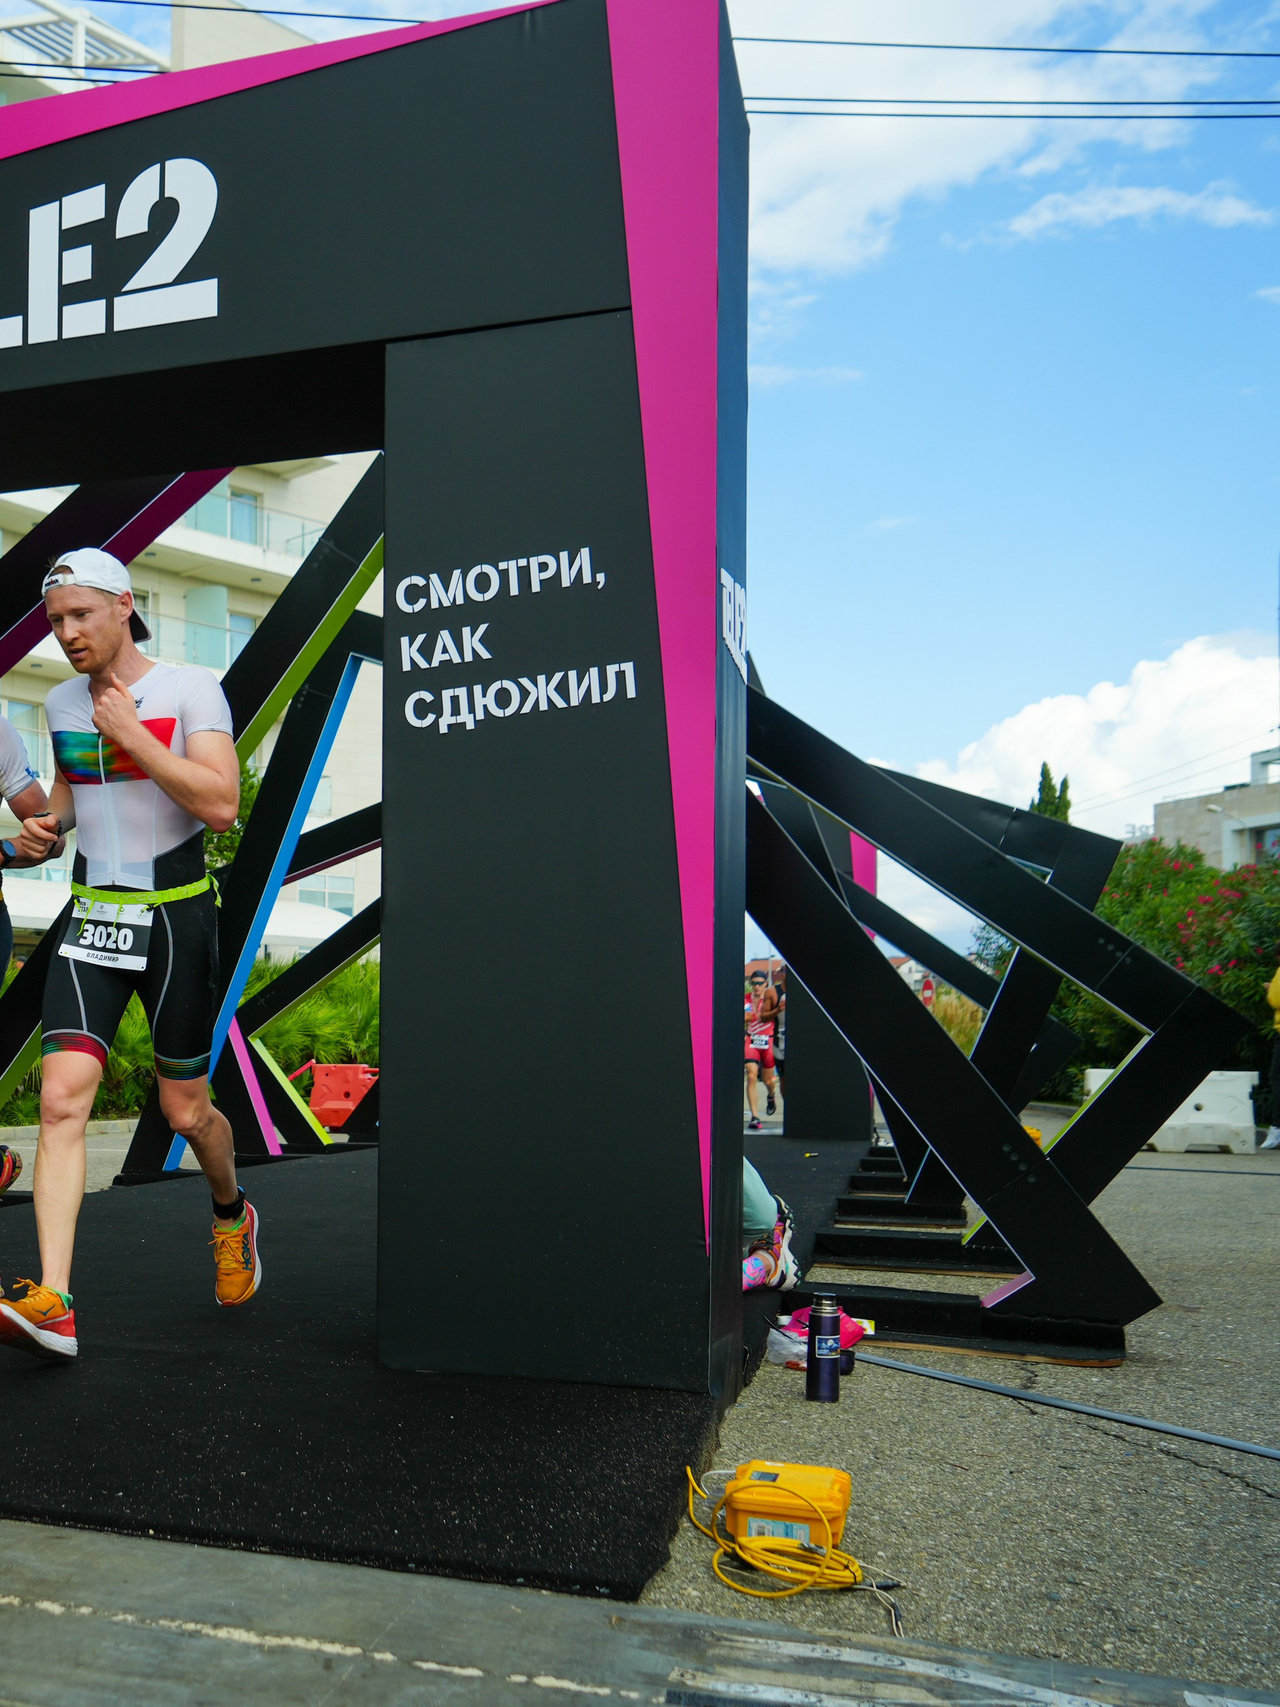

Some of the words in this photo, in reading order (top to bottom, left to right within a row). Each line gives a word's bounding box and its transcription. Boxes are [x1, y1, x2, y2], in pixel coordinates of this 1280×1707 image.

[395, 546, 607, 614] СМОТРИ,
[400, 622, 493, 672] КАК
[404, 661, 637, 734] СДЮЖИЛ
[78, 923, 134, 951] 3020
[86, 952, 120, 963] ВЛАДИМИР
[242, 1232, 253, 1271] HOKA
